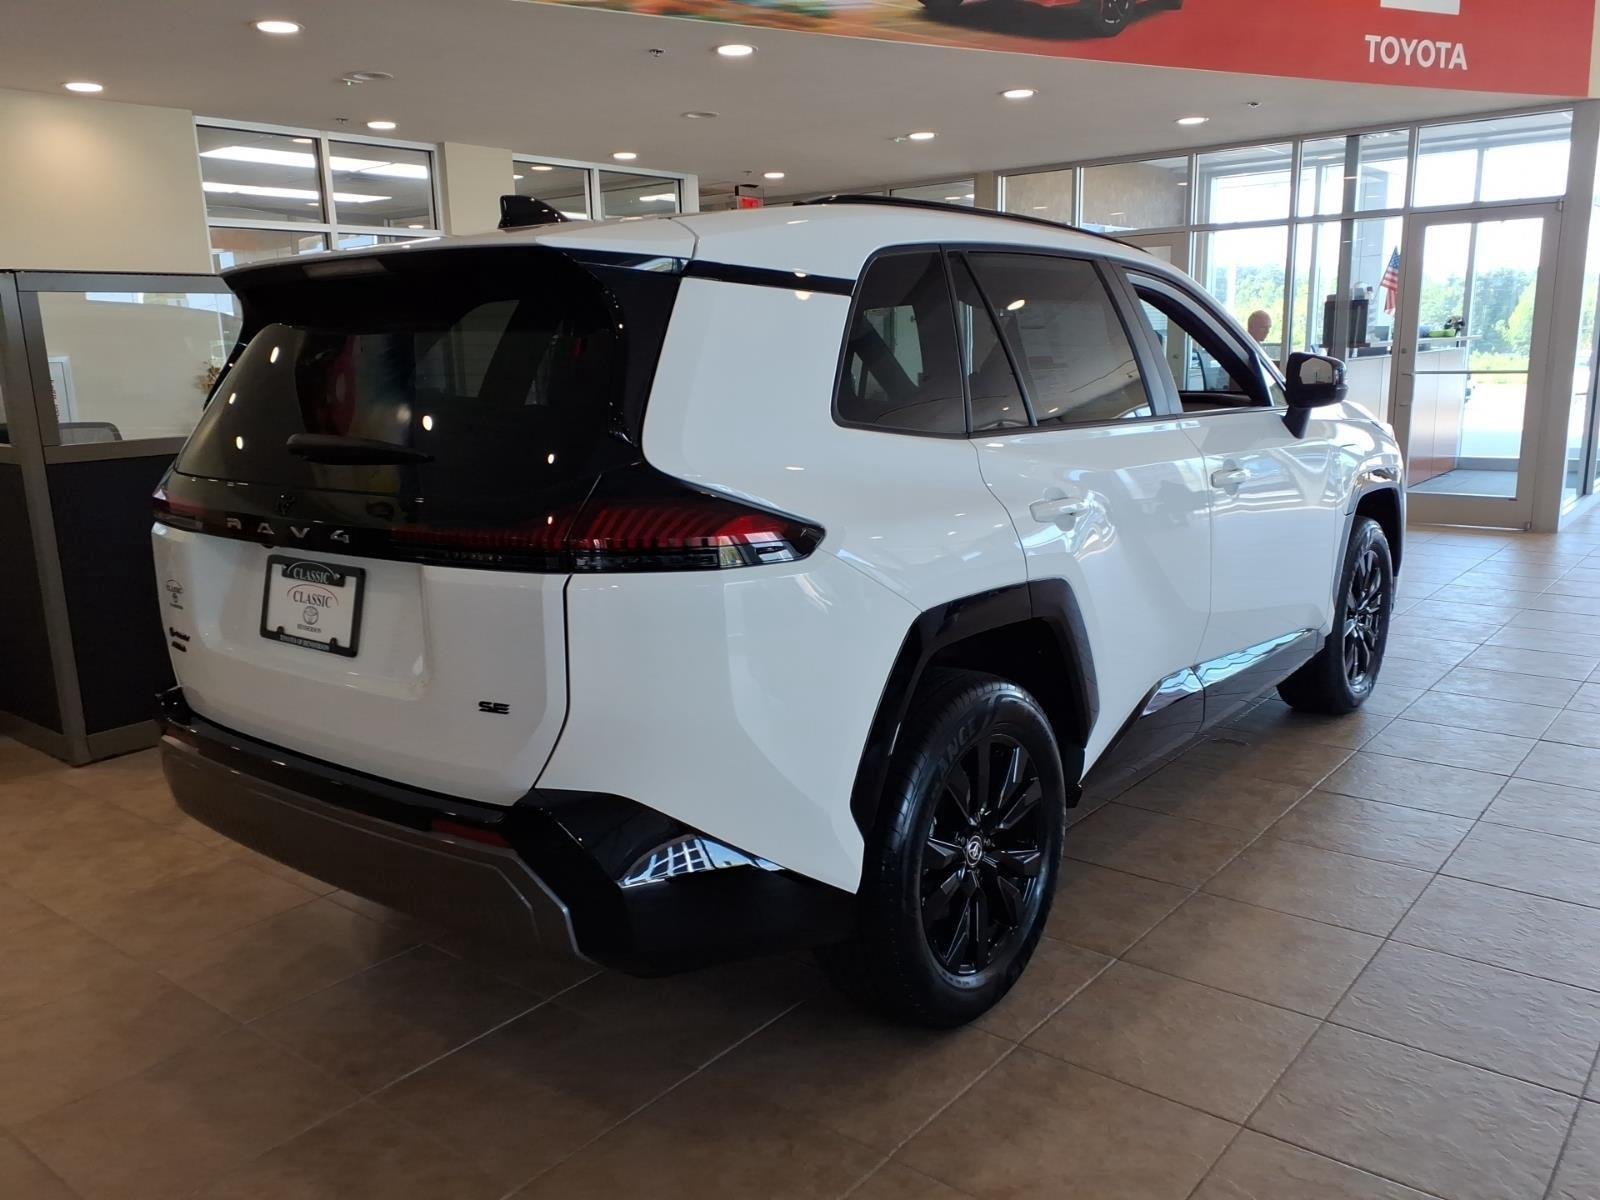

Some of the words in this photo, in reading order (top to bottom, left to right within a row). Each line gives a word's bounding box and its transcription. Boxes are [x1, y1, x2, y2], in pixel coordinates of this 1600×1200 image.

[1364, 34, 1468, 71] TOYOTA
[293, 567, 331, 584] CLASSIC
[293, 590, 333, 609] CLASSIC
[478, 701, 510, 715] SE
